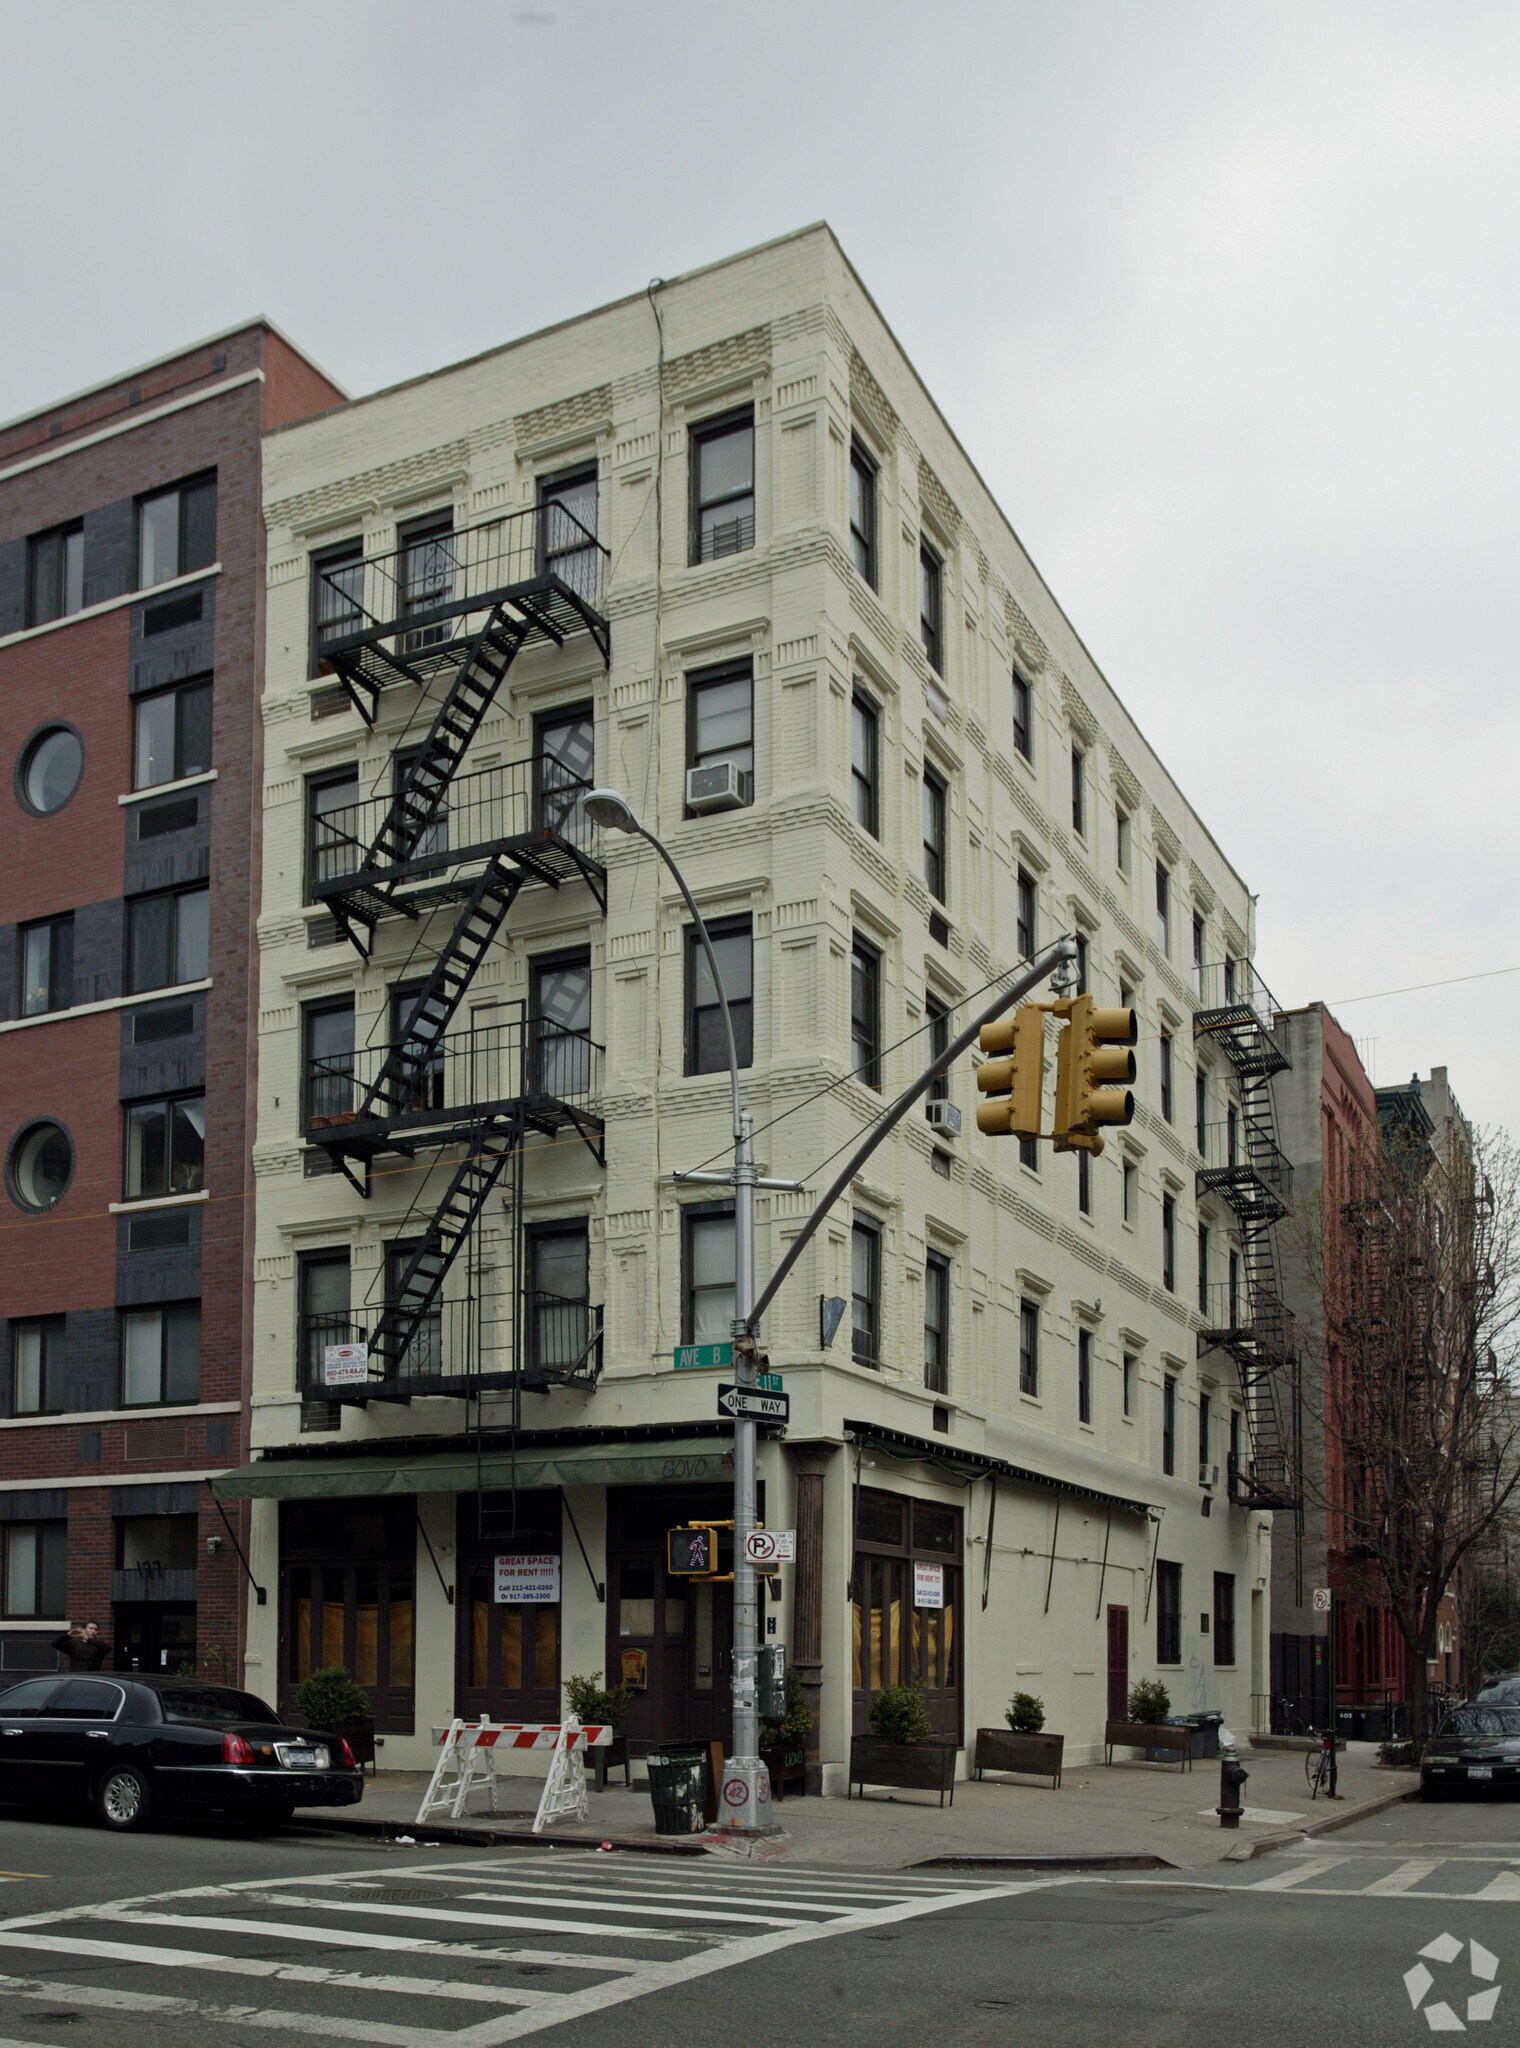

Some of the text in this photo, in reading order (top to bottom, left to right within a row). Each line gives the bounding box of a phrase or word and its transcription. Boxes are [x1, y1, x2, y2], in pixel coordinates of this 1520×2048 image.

[680, 1346, 720, 1366] AVE B
[772, 1376, 779, 1386] ST
[728, 1395, 781, 1413] ONE WAY
[499, 1557, 554, 1565] GREAT SPACE
